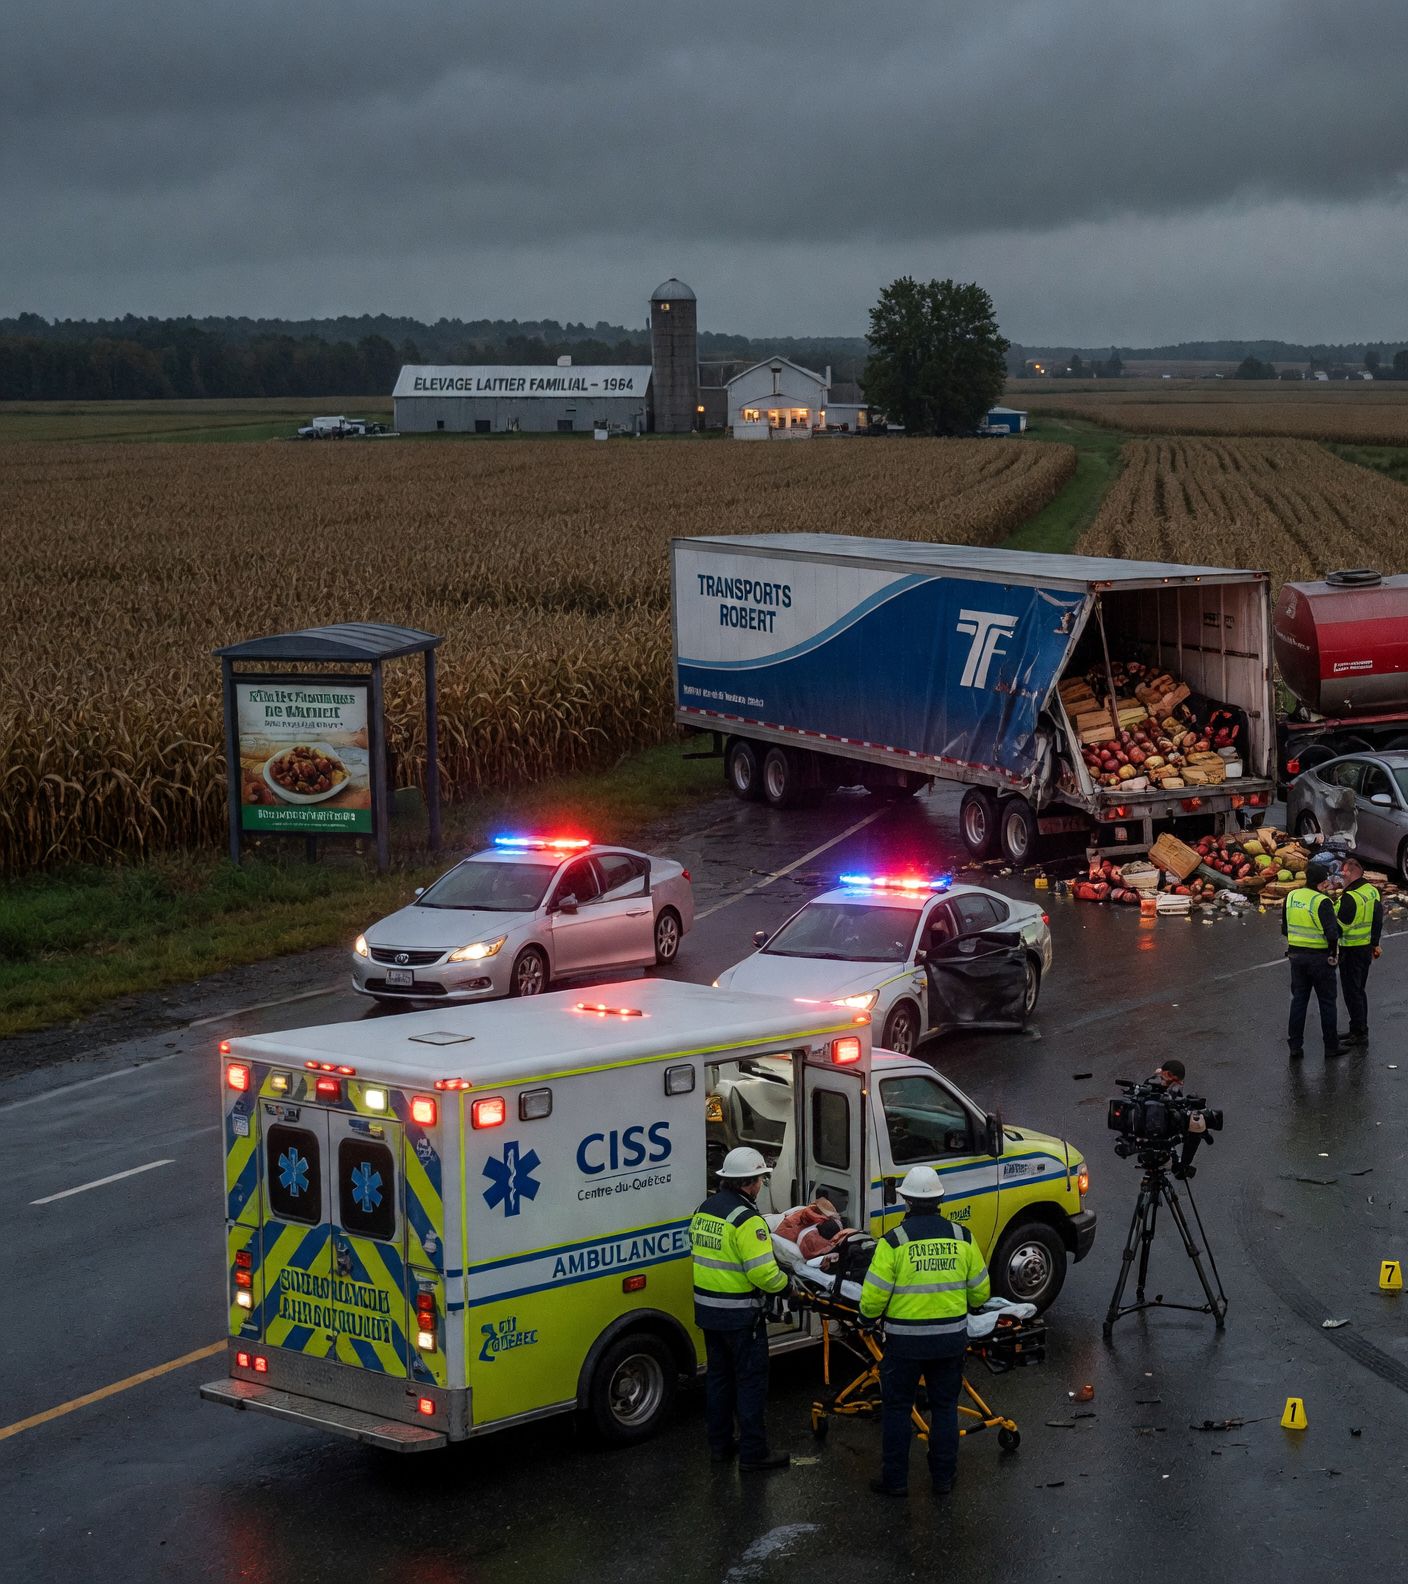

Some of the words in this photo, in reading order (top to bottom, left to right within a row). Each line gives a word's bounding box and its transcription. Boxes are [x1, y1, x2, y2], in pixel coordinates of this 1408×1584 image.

[413, 376, 473, 392] ELEVAGE
[476, 377, 526, 392] LAITIER
[529, 377, 589, 392] FAMILIAL
[602, 377, 634, 391] 1964
[697, 573, 792, 608] TRANSPORTS
[720, 603, 776, 634] ROBERT
[576, 1121, 673, 1175] CISS
[552, 1230, 684, 1279] AMBULANCE
[1384, 1264, 1396, 1283] 7
[1290, 1402, 1297, 1423] 1
